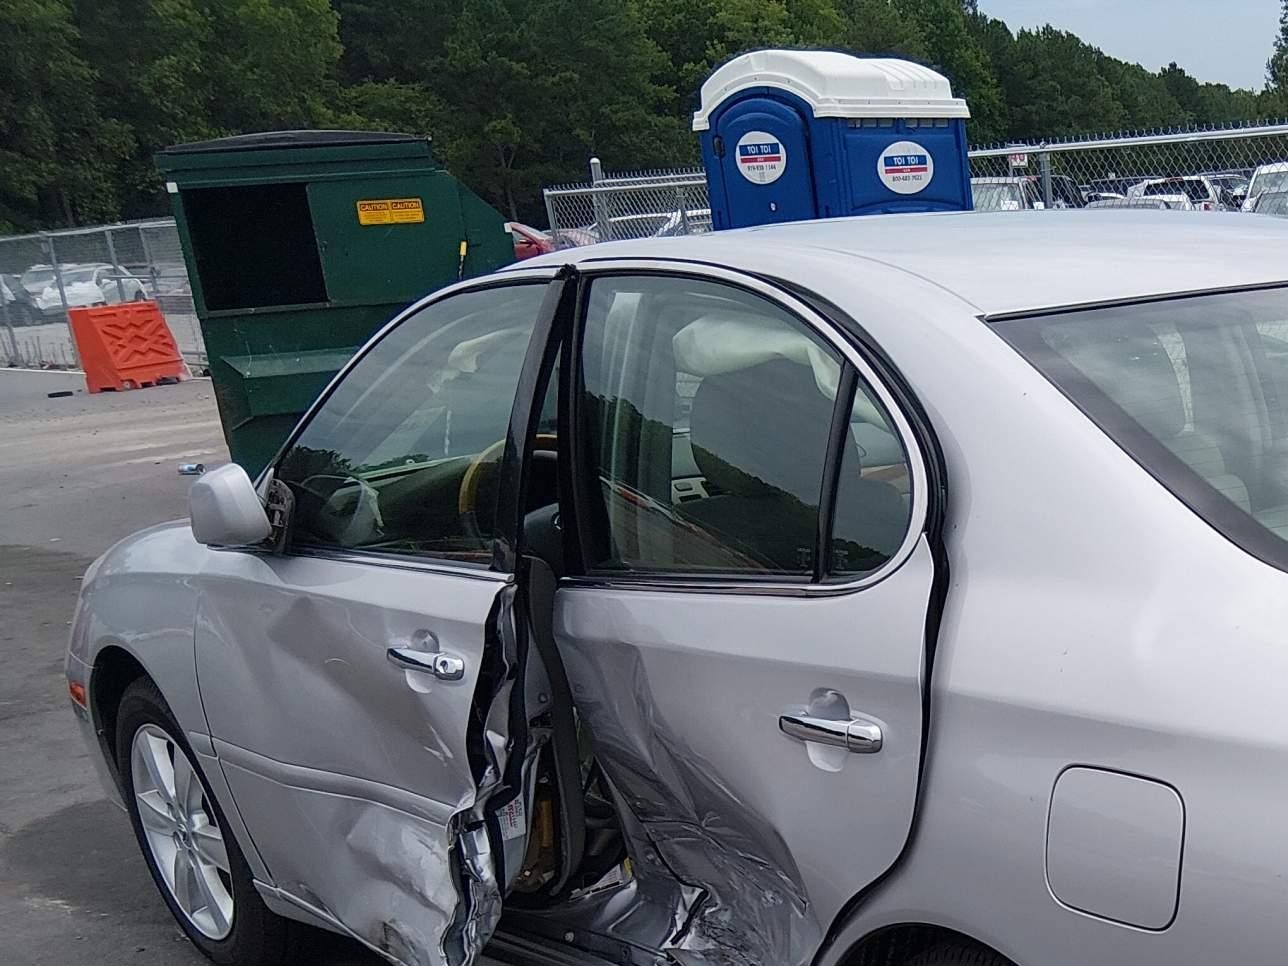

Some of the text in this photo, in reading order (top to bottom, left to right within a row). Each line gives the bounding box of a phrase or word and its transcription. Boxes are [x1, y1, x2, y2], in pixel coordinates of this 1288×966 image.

[747, 144, 772, 154] TOI TOI
[893, 155, 919, 165] TOI TOI
[360, 203, 387, 211] CAUTION
[392, 201, 419, 209] CAUTION
